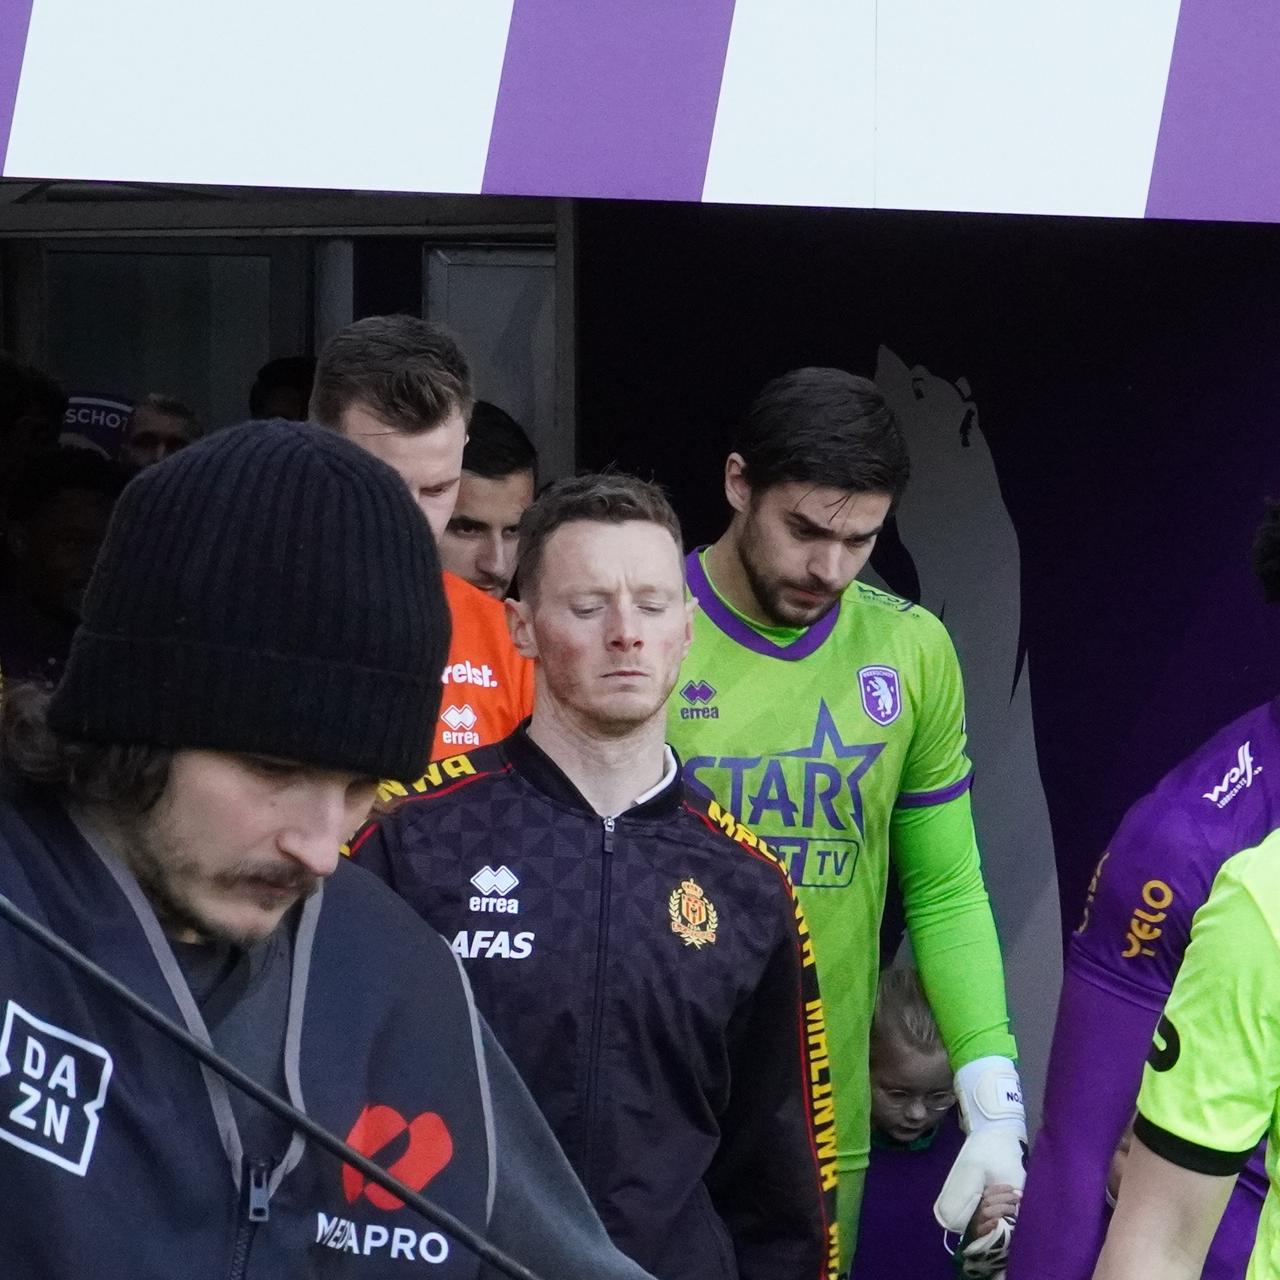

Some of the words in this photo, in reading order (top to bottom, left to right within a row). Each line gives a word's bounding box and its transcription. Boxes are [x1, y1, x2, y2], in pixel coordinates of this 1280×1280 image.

[682, 756, 847, 831] STAR
[817, 851, 850, 876] TV
[452, 930, 535, 959] AFAS
[1121, 880, 1174, 957] YELO
